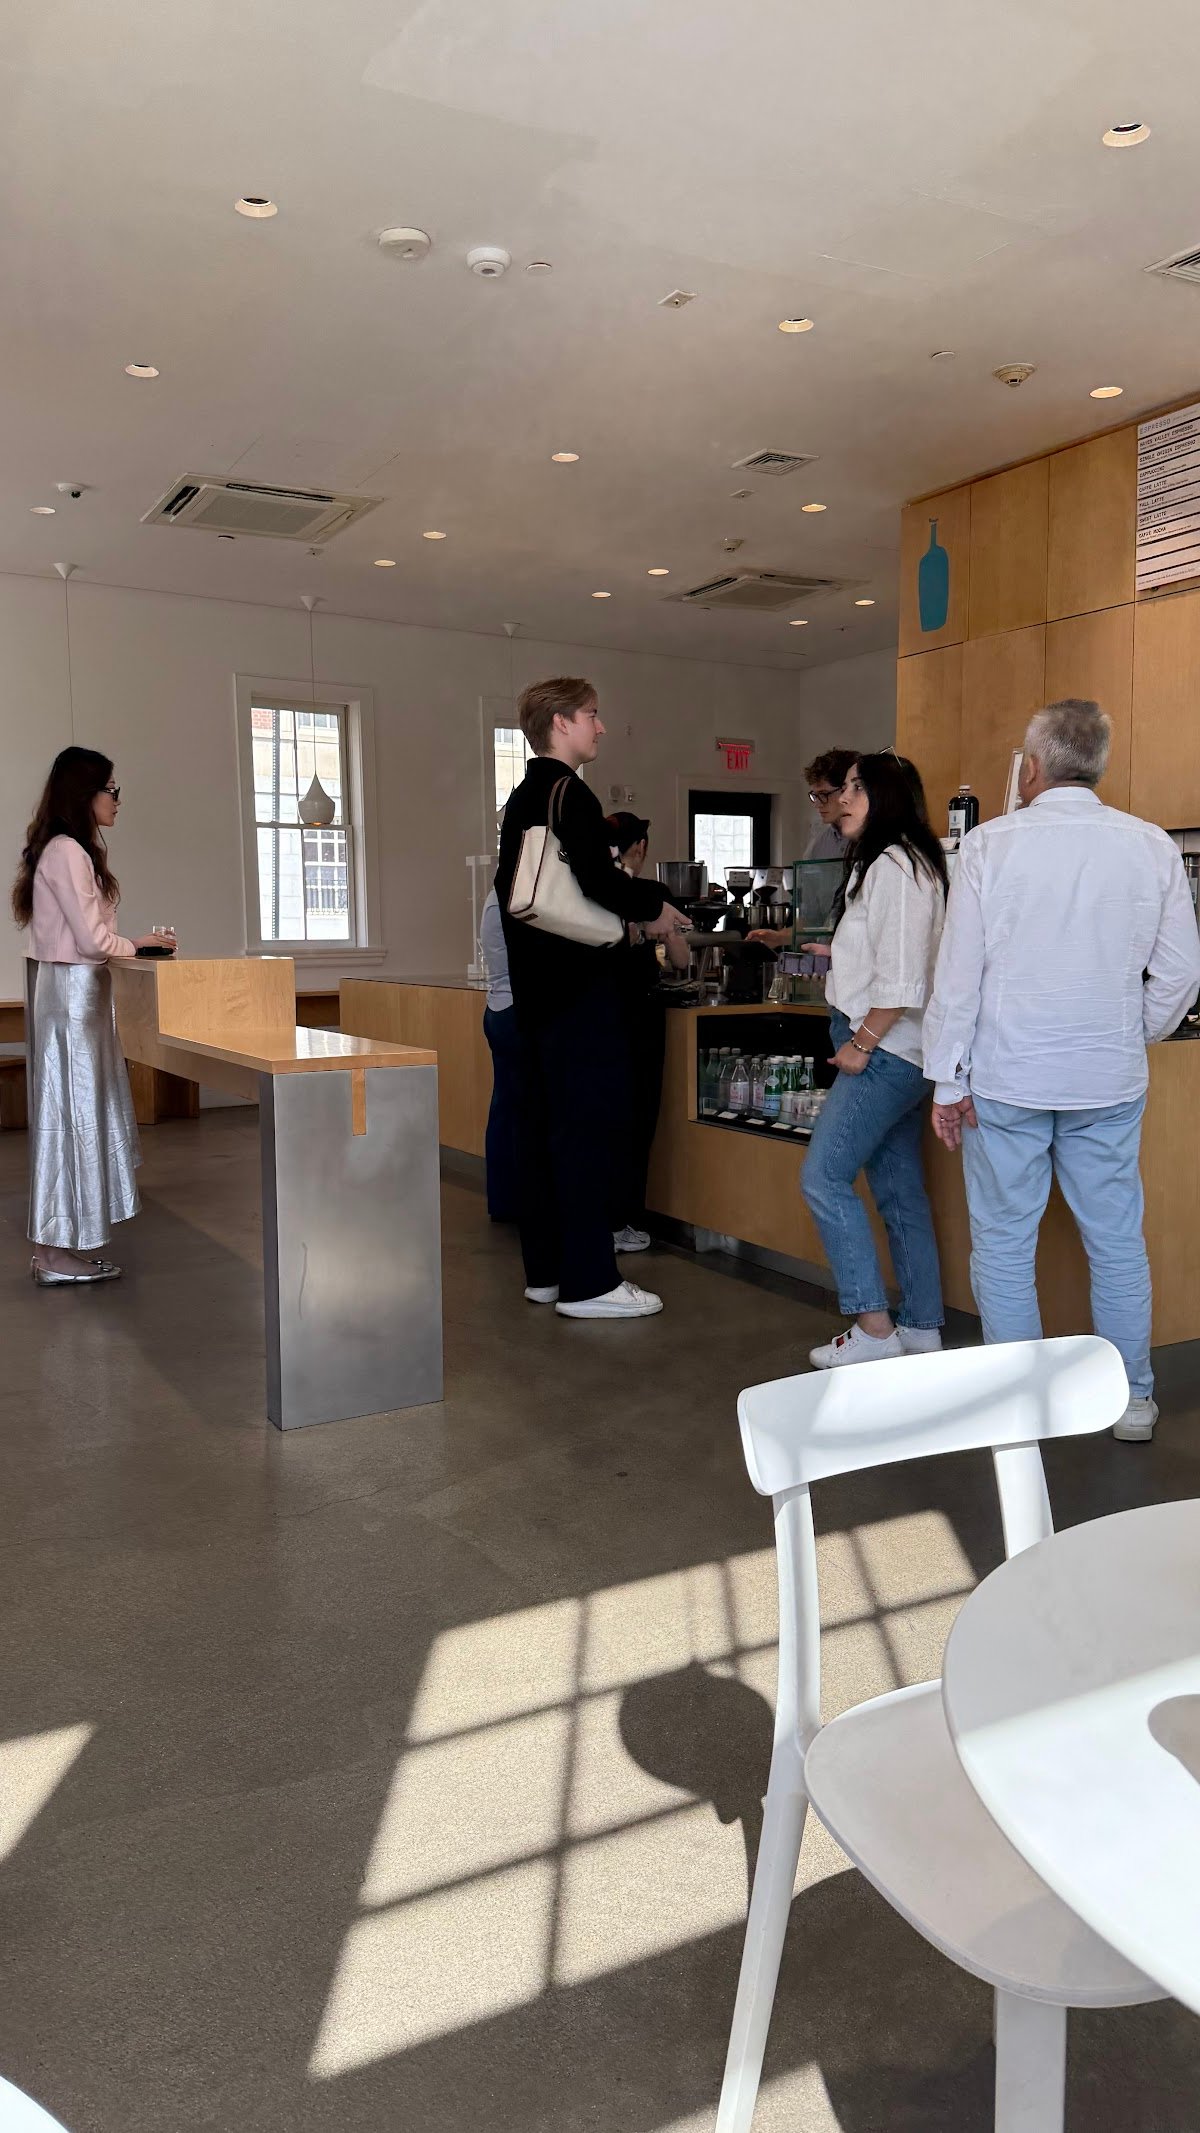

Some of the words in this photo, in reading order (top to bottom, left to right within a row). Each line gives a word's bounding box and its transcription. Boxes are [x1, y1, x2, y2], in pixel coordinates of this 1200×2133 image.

[1140, 418, 1170, 434] ESPRESSO
[1171, 424, 1194, 436] ESPRESSO
[1139, 453, 1155, 463] SINGLE
[1153, 479, 1167, 488] LATTE
[727, 750, 750, 770] EXIT
